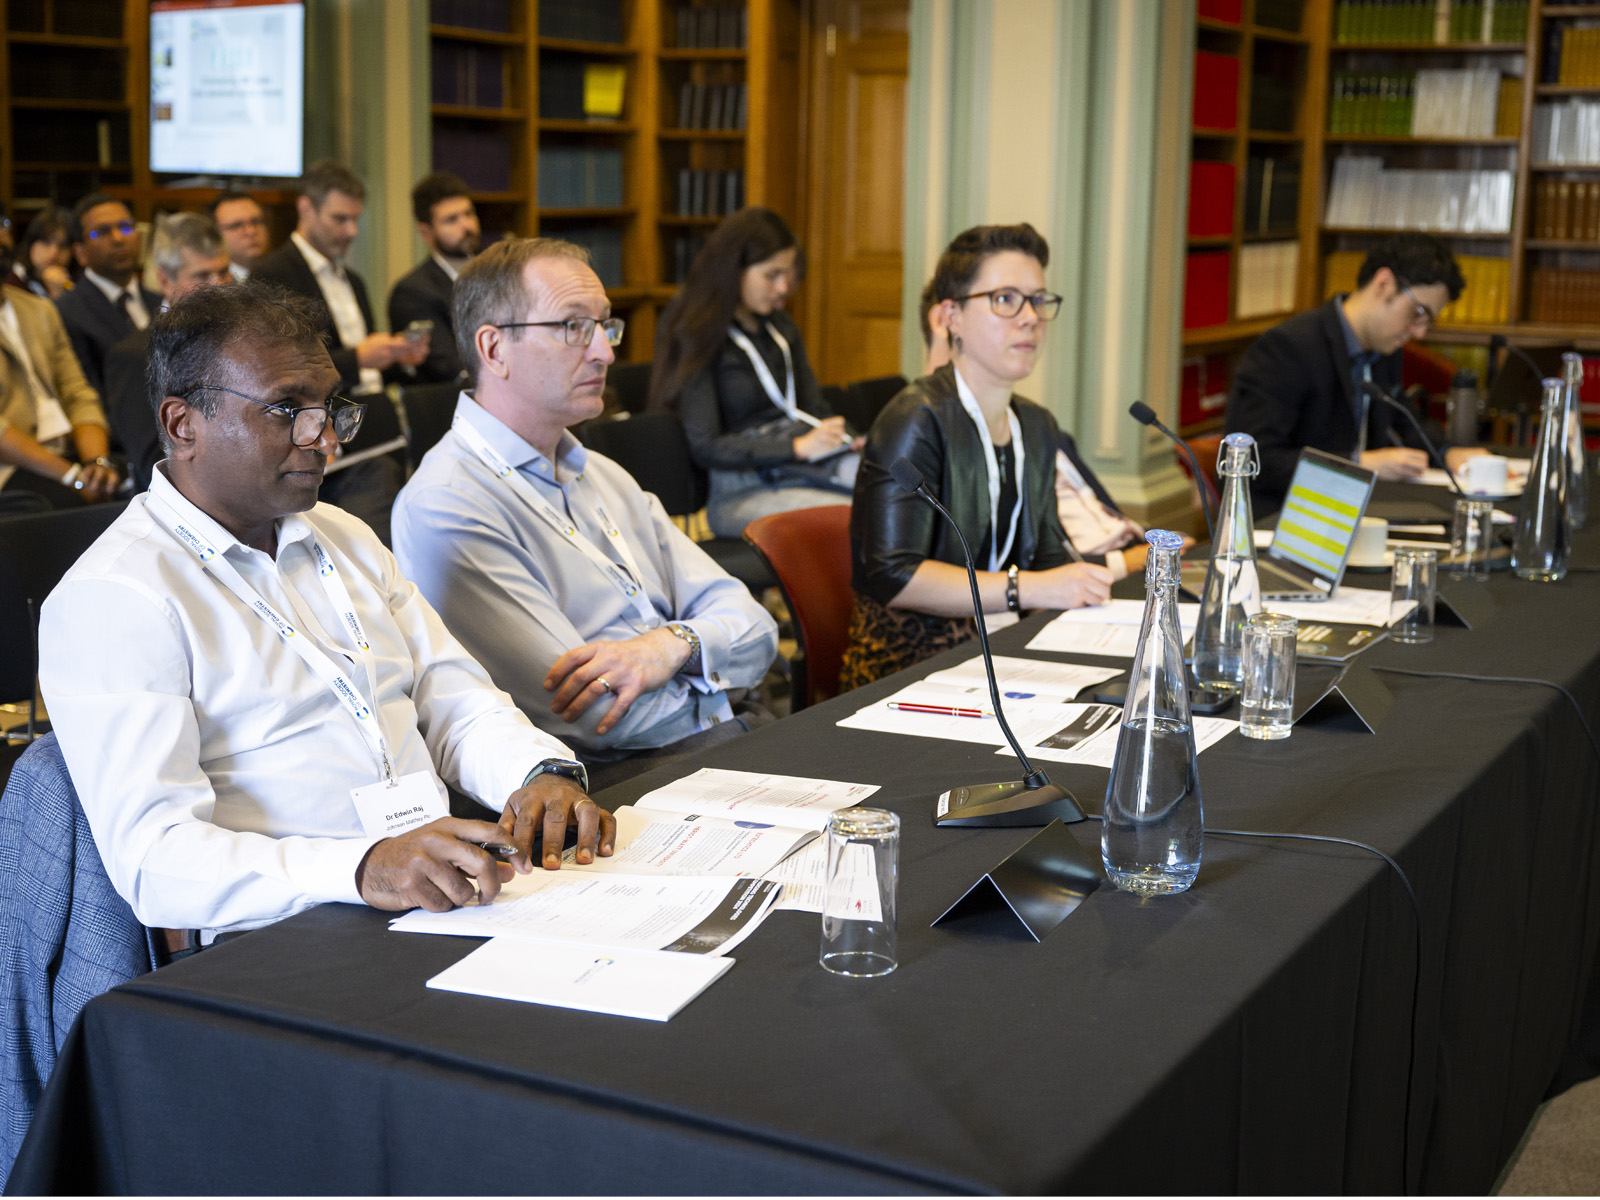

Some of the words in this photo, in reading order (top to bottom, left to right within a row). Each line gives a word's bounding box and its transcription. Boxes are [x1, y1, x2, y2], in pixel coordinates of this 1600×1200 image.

[178, 525, 200, 544] CHEMISTRY
[336, 676, 357, 701] CHEMISTRY
[393, 809, 413, 819] Edwin
